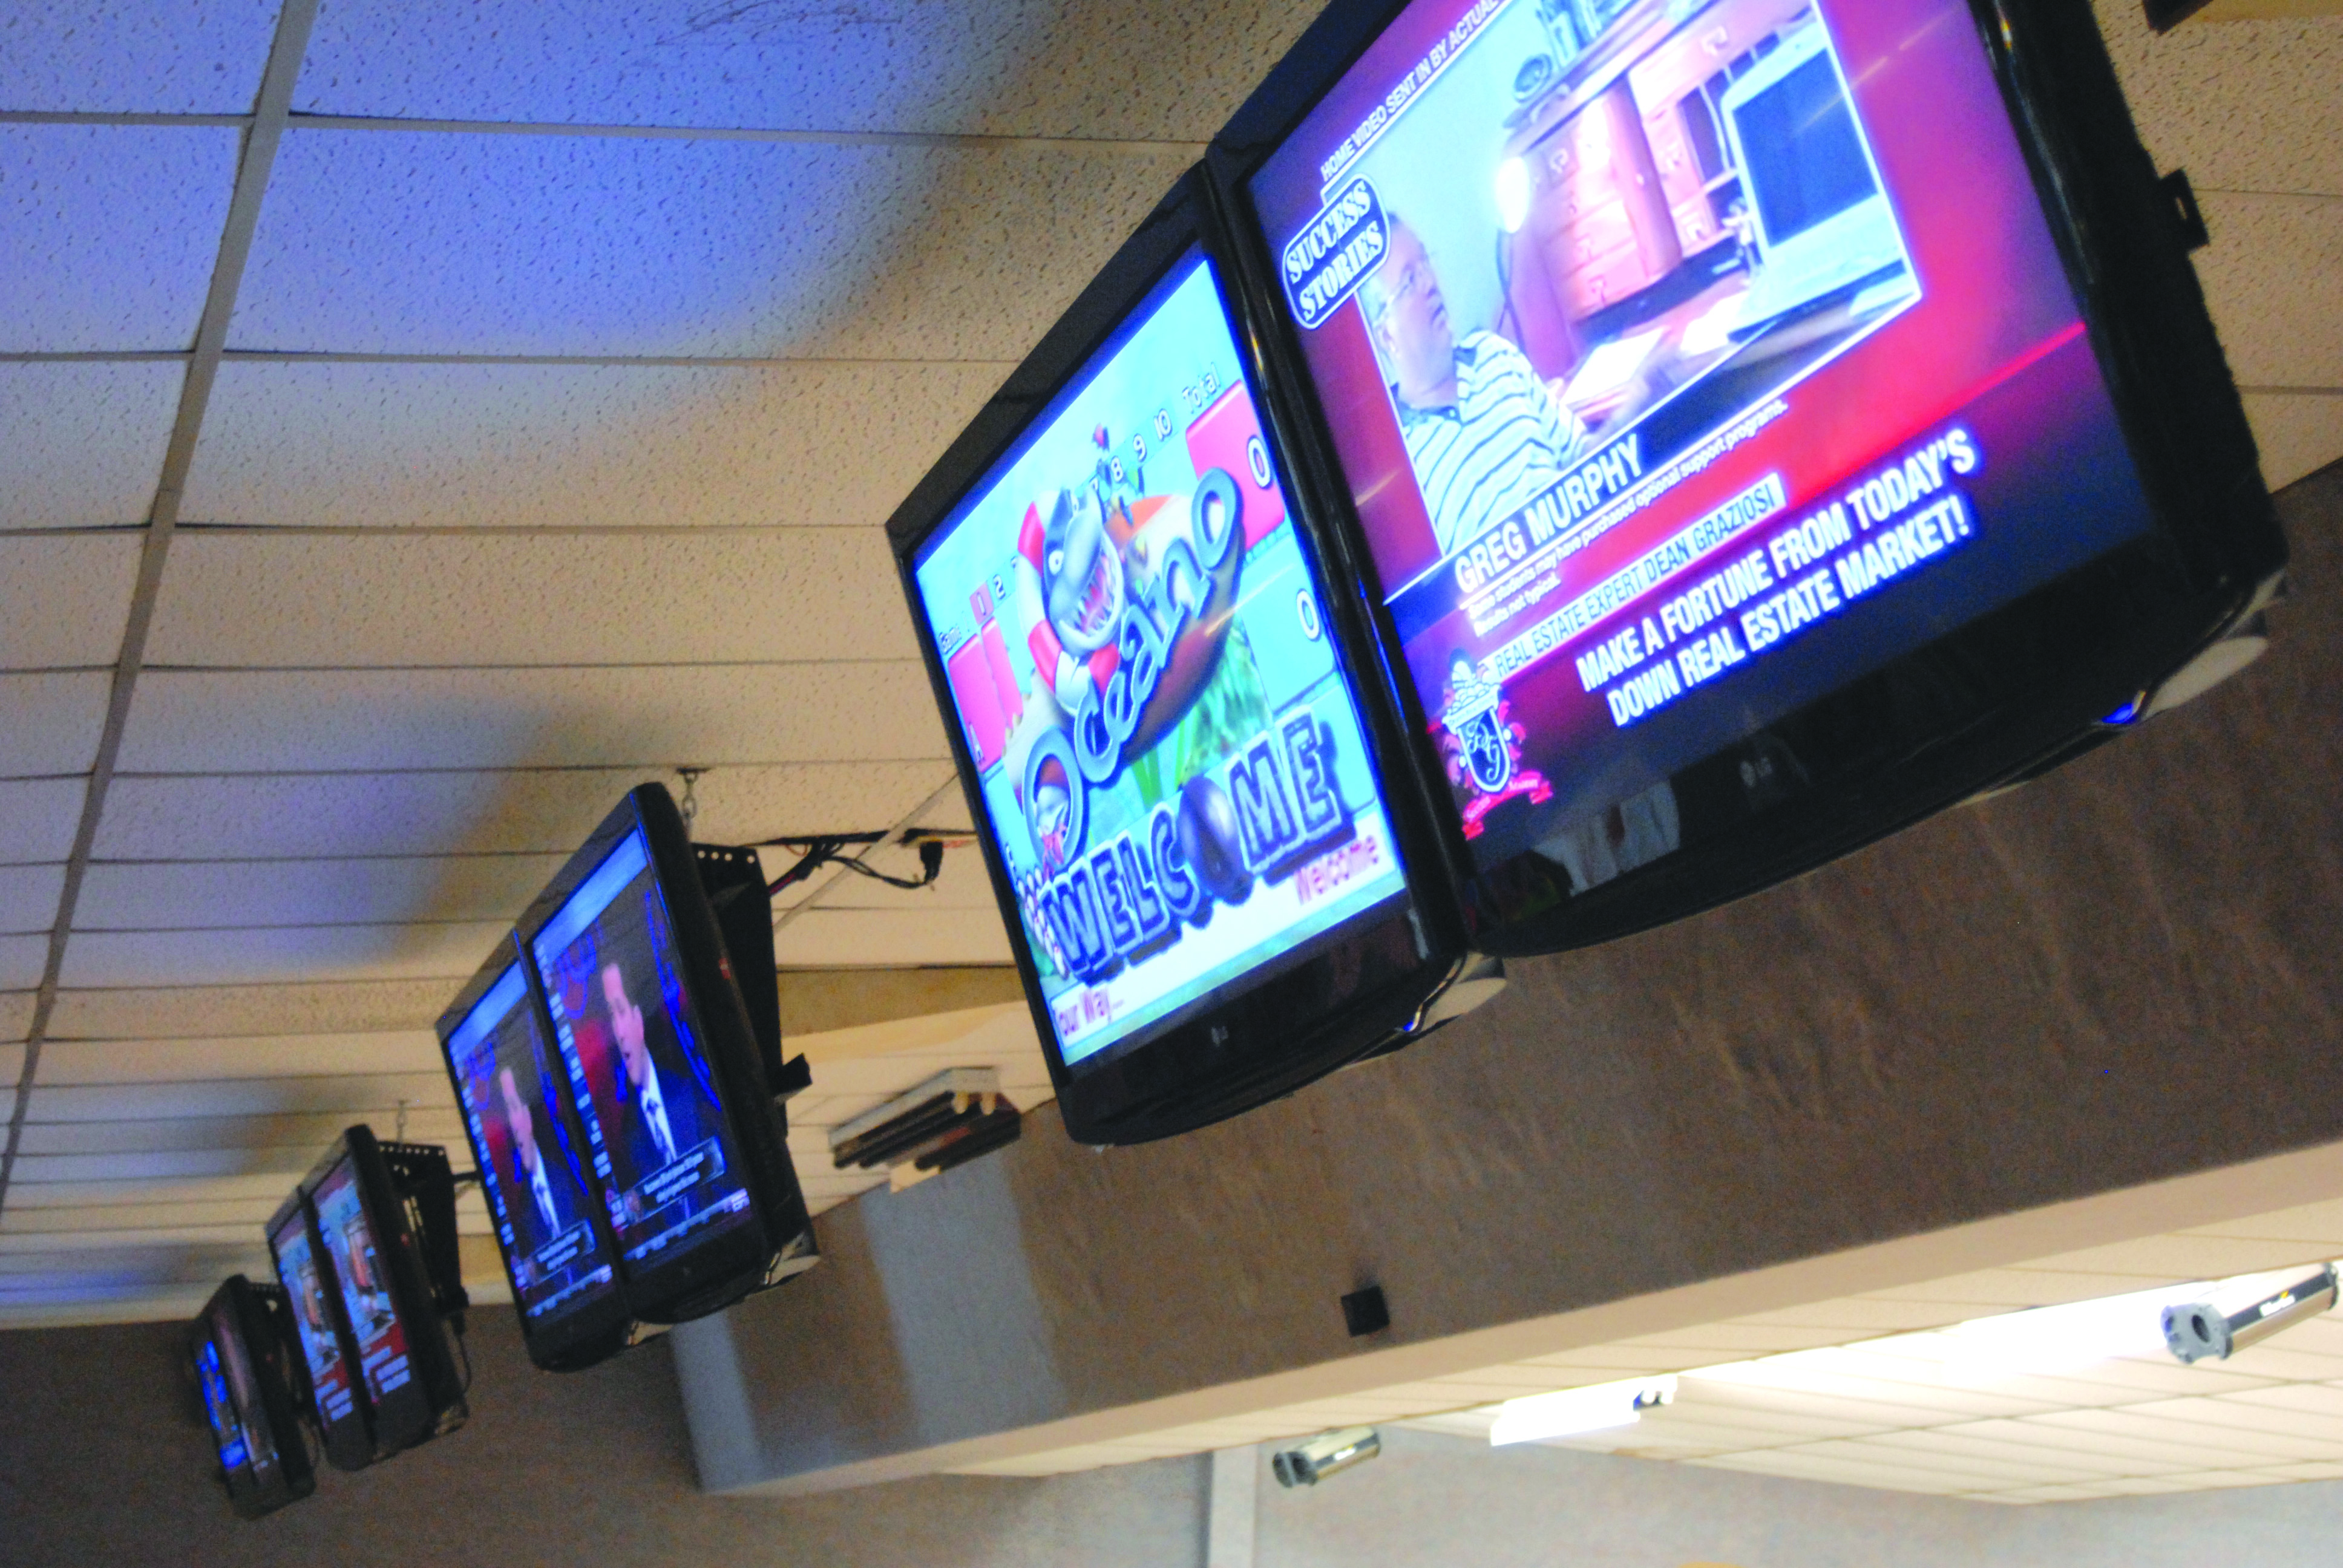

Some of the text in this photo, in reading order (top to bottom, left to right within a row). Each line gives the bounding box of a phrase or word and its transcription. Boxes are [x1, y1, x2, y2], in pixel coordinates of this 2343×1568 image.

[1320, 137, 1355, 182] HOME
[1351, 105, 1387, 148] VIDEO
[1385, 71, 1417, 114] SENT
[1415, 57, 1432, 83] IN
[1429, 38, 1447, 69] BY
[1285, 179, 1371, 284] SUCCESS
[1300, 220, 1384, 322] STORIES
[1181, 361, 1222, 414] Total
[992, 573, 1006, 600] 2
[1110, 455, 1124, 484] 8
[1132, 433, 1148, 463] 9
[1152, 408, 1173, 442] 10
[1454, 433, 1642, 593] GREG MURPHY
[1495, 483, 1775, 679] REAL ESTATE EXPERT DEAN GRAZIOSI
[1575, 428, 1975, 693] MAKE A FORTUNE FROM TODAY'S
[1607, 494, 1969, 727] DOWN REAL ESTATE MARKET!
[1037, 703, 1357, 987] WELCOME
